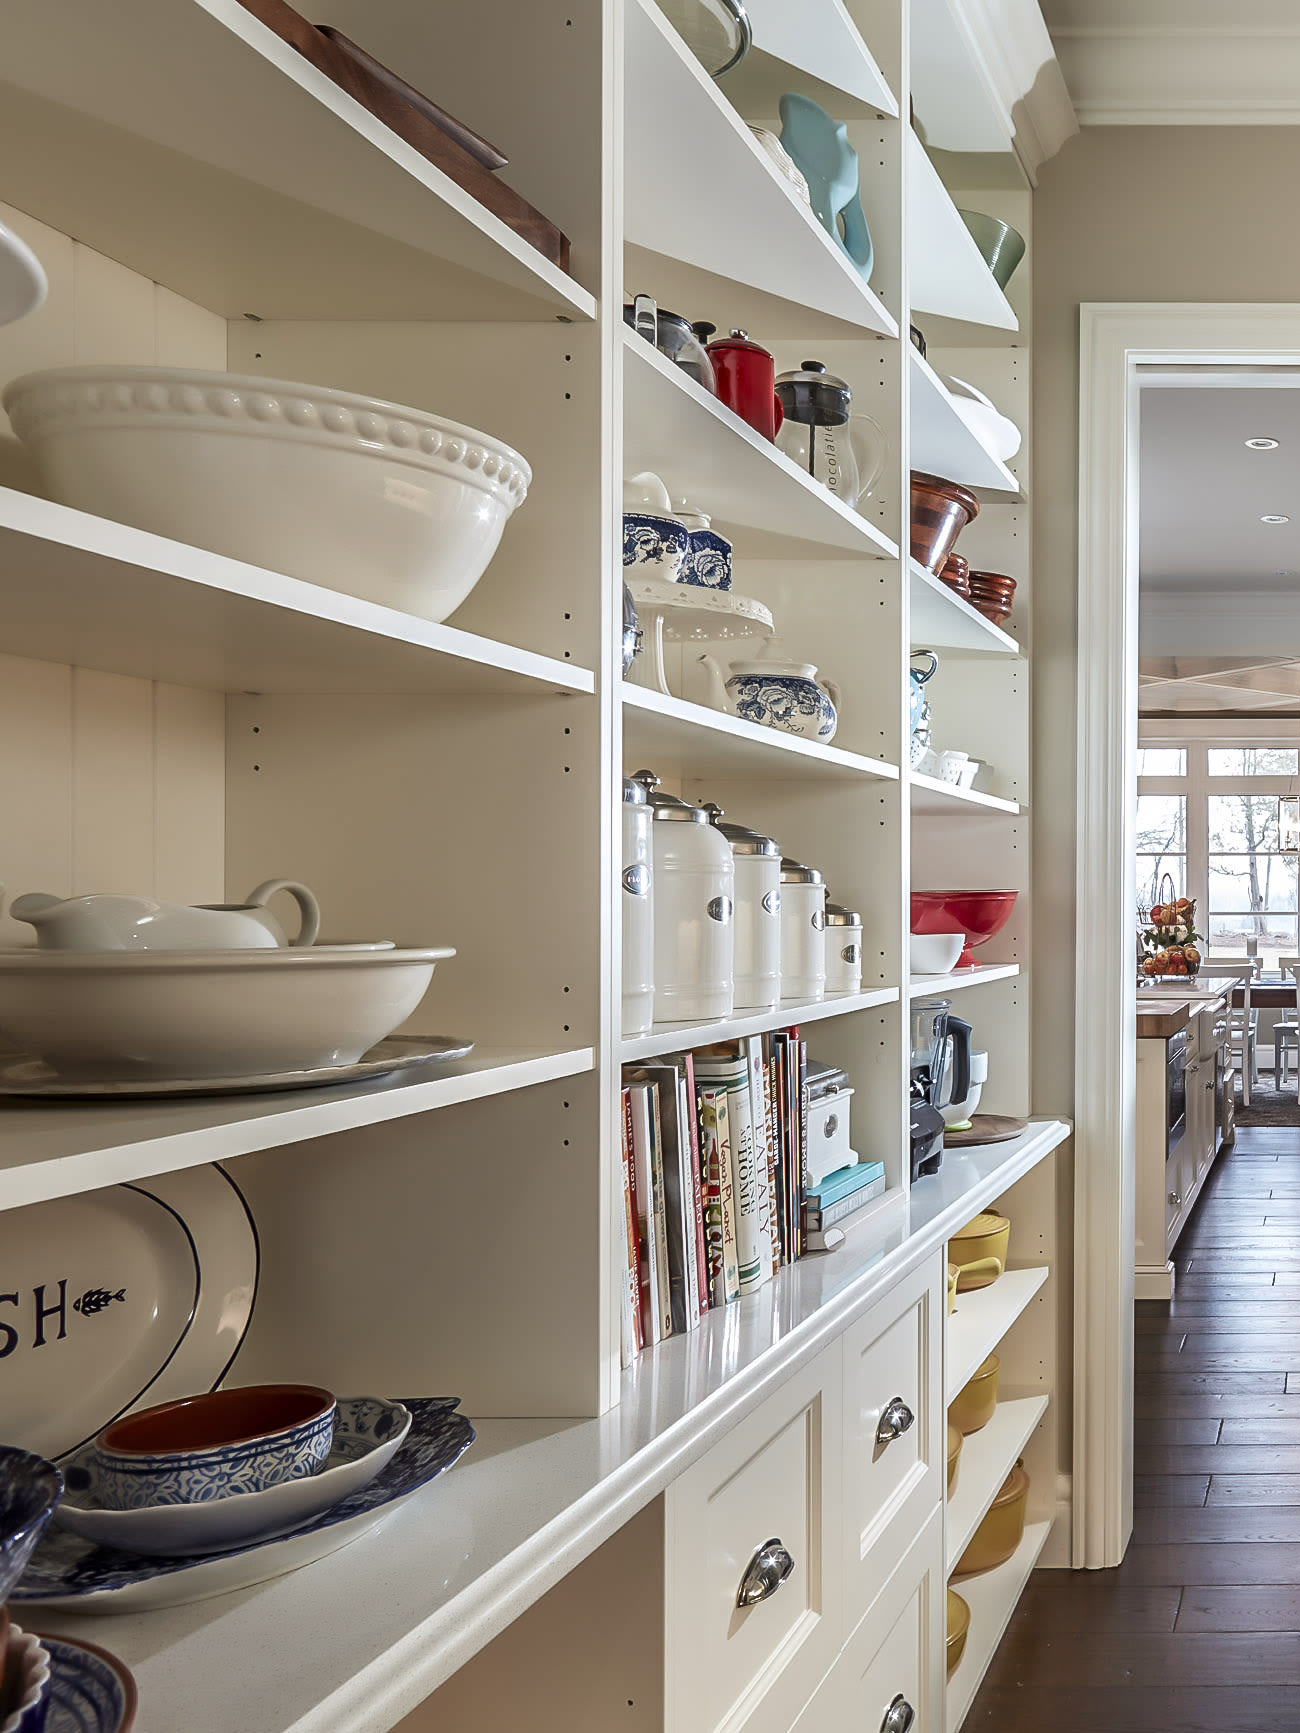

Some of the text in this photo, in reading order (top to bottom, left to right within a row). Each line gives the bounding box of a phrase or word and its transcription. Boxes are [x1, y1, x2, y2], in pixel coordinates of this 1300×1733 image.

[625, 1101, 636, 1152] JAMIE'S
[772, 1102, 780, 1165] GARDE-MANGER
[628, 1155, 637, 1192] FOOD
[717, 1139, 732, 1184] Vegan
[737, 1148, 752, 1217] HOME
[755, 1123, 770, 1238] EATALY
[694, 1173, 702, 1224] PALEO
[631, 1245, 639, 1272] JAMIE
[633, 1273, 641, 1306] OLIVER
